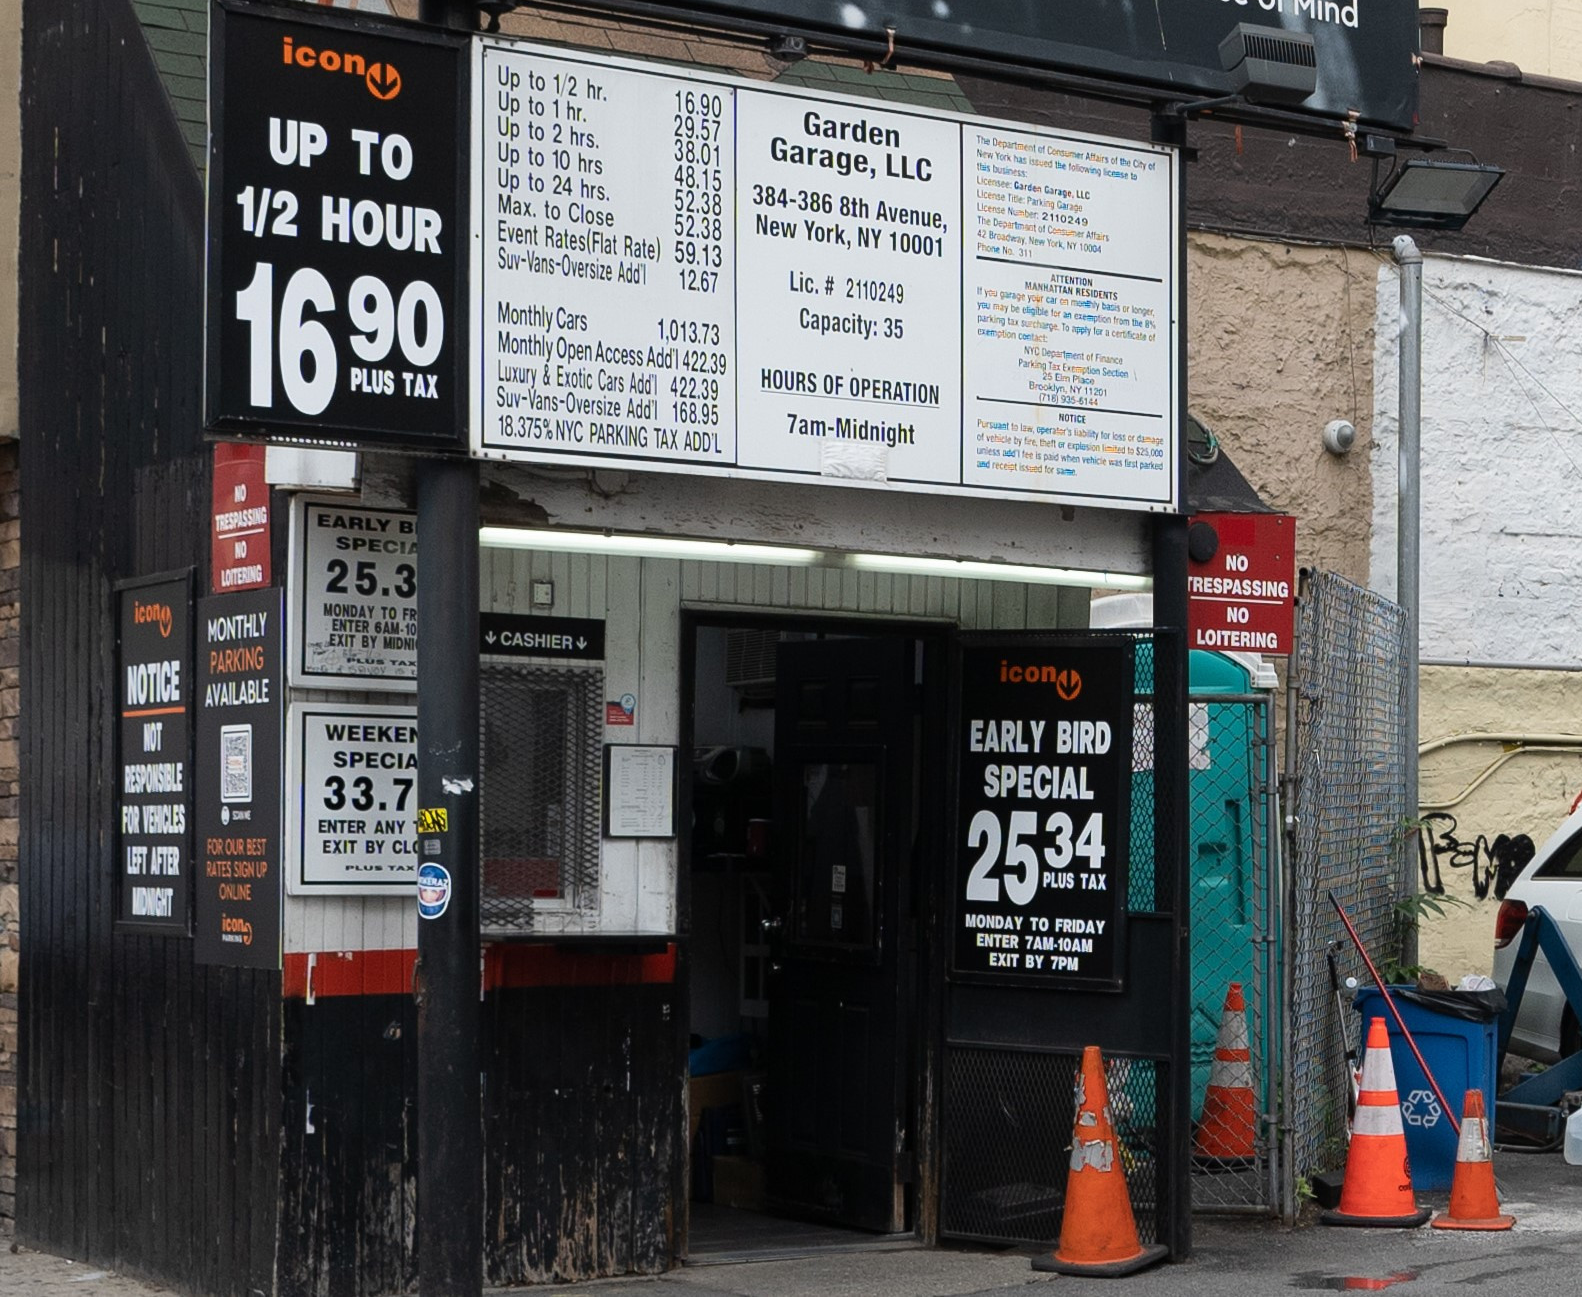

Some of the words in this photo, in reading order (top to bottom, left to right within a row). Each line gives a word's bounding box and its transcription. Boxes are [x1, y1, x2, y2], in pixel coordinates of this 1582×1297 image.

[283, 36, 365, 75] icon
[498, 65, 520, 89] Up
[529, 71, 545, 91] to
[553, 73, 577, 97] 1/2
[587, 78, 607, 102] hr.
[675, 90, 722, 118] 16.90
[499, 90, 520, 115] Up
[529, 96, 544, 116] to
[554, 99, 559, 118] 1
[567, 101, 587, 122] hr.
[674, 115, 721, 142] 29.57
[804, 111, 899, 148] Garden
[269, 117, 328, 168] UP
[351, 129, 413, 180] TO
[498, 116, 520, 140] Up
[529, 121, 544, 141] to
[553, 124, 562, 144] 2
[571, 126, 599, 149] hrs.
[675, 139, 720, 167] 38.01
[771, 137, 876, 179] Garage,
[886, 153, 932, 181] LLC
[1014, 181, 1042, 193] Garden
[1076, 190, 1090, 200] LLC
[237, 186, 299, 237] 1/2
[322, 195, 442, 254] HOUR
[498, 194, 536, 218] Max.
[545, 201, 560, 220] to
[569, 203, 614, 227] Close
[675, 215, 722, 241] 52.38
[753, 184, 833, 214] 384-386
[840, 196, 869, 218] 8th
[876, 201, 947, 234] Avenue,
[977, 203, 1005, 215] License
[1042, 212, 1088, 227] 2110249
[498, 220, 537, 246] Event
[624, 236, 661, 262] Rate)
[675, 242, 722, 268] 59.13
[757, 214, 797, 238] New
[804, 220, 850, 250] York,
[858, 227, 882, 249] NY
[890, 231, 942, 257] 10001
[498, 247, 612, 281] Suv-Vans-Oversize
[680, 269, 719, 293] 12.67
[1051, 274, 1093, 287] ATTENTION
[790, 271, 819, 294] Lic.
[825, 275, 834, 295] #
[846, 278, 904, 304] 2110249
[1025, 281, 1073, 296] MANHATTAN
[1075, 288, 1118, 301] RESIDENTS
[498, 301, 553, 332] Monthly
[556, 307, 587, 331] Cars
[658, 318, 720, 345] 1,013.73
[800, 308, 877, 340] Capacity:
[884, 318, 903, 339] 35
[498, 331, 553, 363] Monthly
[557, 337, 592, 364] Open
[596, 341, 643, 366] Access
[683, 351, 726, 375] 422.39
[351, 367, 395, 395] PLUS
[403, 372, 439, 399] TAX
[498, 360, 536, 389] Luxury
[543, 364, 551, 386] &
[557, 365, 593, 390] Exotic
[598, 369, 624, 393] Cars
[671, 376, 719, 401] 422.39
[761, 368, 817, 393] HOURS
[824, 374, 844, 395] OF
[850, 377, 939, 404] OPERATION
[498, 415, 553, 440] 18.375%
[556, 420, 583, 443] NYC
[590, 422, 648, 448] PARKING
[654, 428, 678, 450] TAX
[787, 413, 915, 447] 7am-Midnight
[1059, 413, 1086, 424] NOTICE
[234, 484, 246, 503] NO
[215, 506, 267, 532] TRESPASSING
[317, 514, 391, 532] EARLY
[234, 541, 247, 560] NO
[1226, 555, 1248, 571] NO
[221, 564, 263, 587] LOITERING
[208, 612, 267, 643] MONTHLY
[1227, 607, 1249, 623] NO
[500, 631, 573, 650] CASHIER
[1197, 629, 1278, 649] LOITERING
[210, 646, 264, 675] PARKING
[1000, 660, 1056, 683] icon
[128, 660, 180, 705] NOTICE
[205, 678, 269, 708] AVAILABLE
[144, 722, 162, 752] NOT
[970, 719, 1046, 753] EARLY
[1057, 721, 1111, 755] BIRD
[984, 765, 1094, 800] SPECIAL
[319, 820, 366, 834] ENTER
[374, 820, 405, 835] ANY
[323, 840, 357, 854] EXIT
[366, 840, 385, 854] BY
[1043, 871, 1075, 889] PLUS
[1081, 873, 1107, 891] TAX
[965, 914, 1024, 930] MONDAY
[1030, 917, 1048, 932] TO
[1055, 918, 1105, 934] FRIDAY
[977, 933, 1018, 949] ENTER
[1025, 936, 1093, 953] 7AM-10AM
[989, 952, 1019, 968] EXIT
[1026, 955, 1044, 969] BY
[1051, 956, 1078, 971] 7PM
